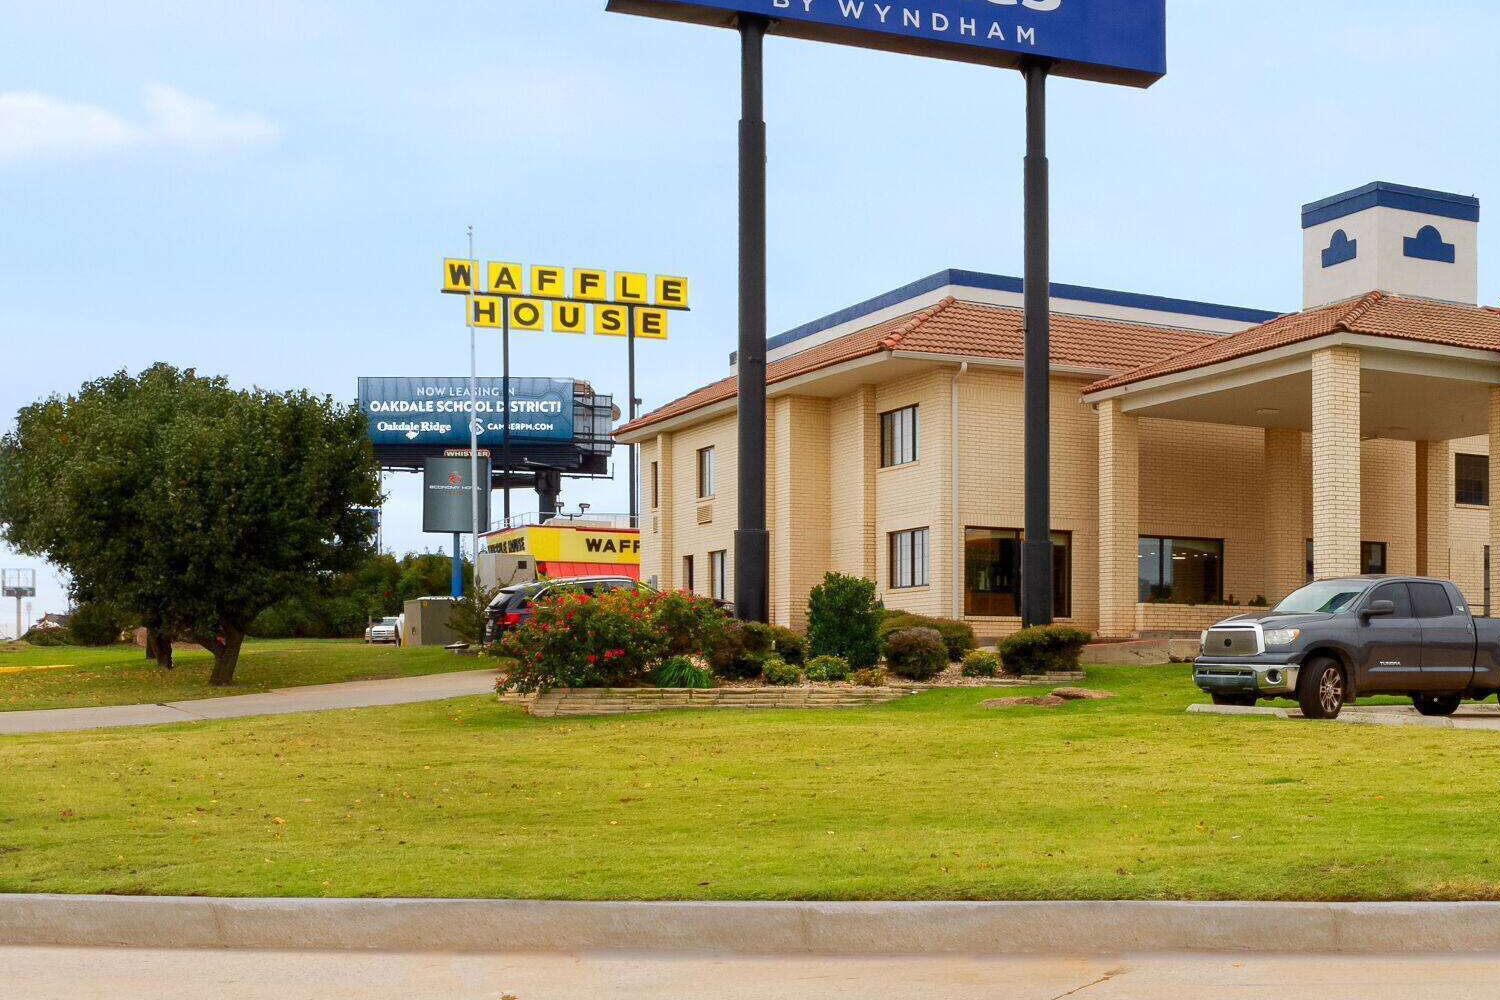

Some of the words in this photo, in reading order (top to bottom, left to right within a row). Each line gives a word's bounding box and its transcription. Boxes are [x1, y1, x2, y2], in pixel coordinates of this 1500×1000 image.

[448, 262, 682, 302] WAFFLE
[473, 300, 661, 334] HOUSE
[416, 386, 445, 397] NOW
[369, 400, 434, 413] OAKDALE
[436, 400, 494, 413] SCHOOL
[496, 400, 562, 413] DSTRICT!
[377, 421, 420, 432] Oakdale
[420, 421, 452, 433] Ridge
[487, 422, 554, 431] CAMERPM.COM
